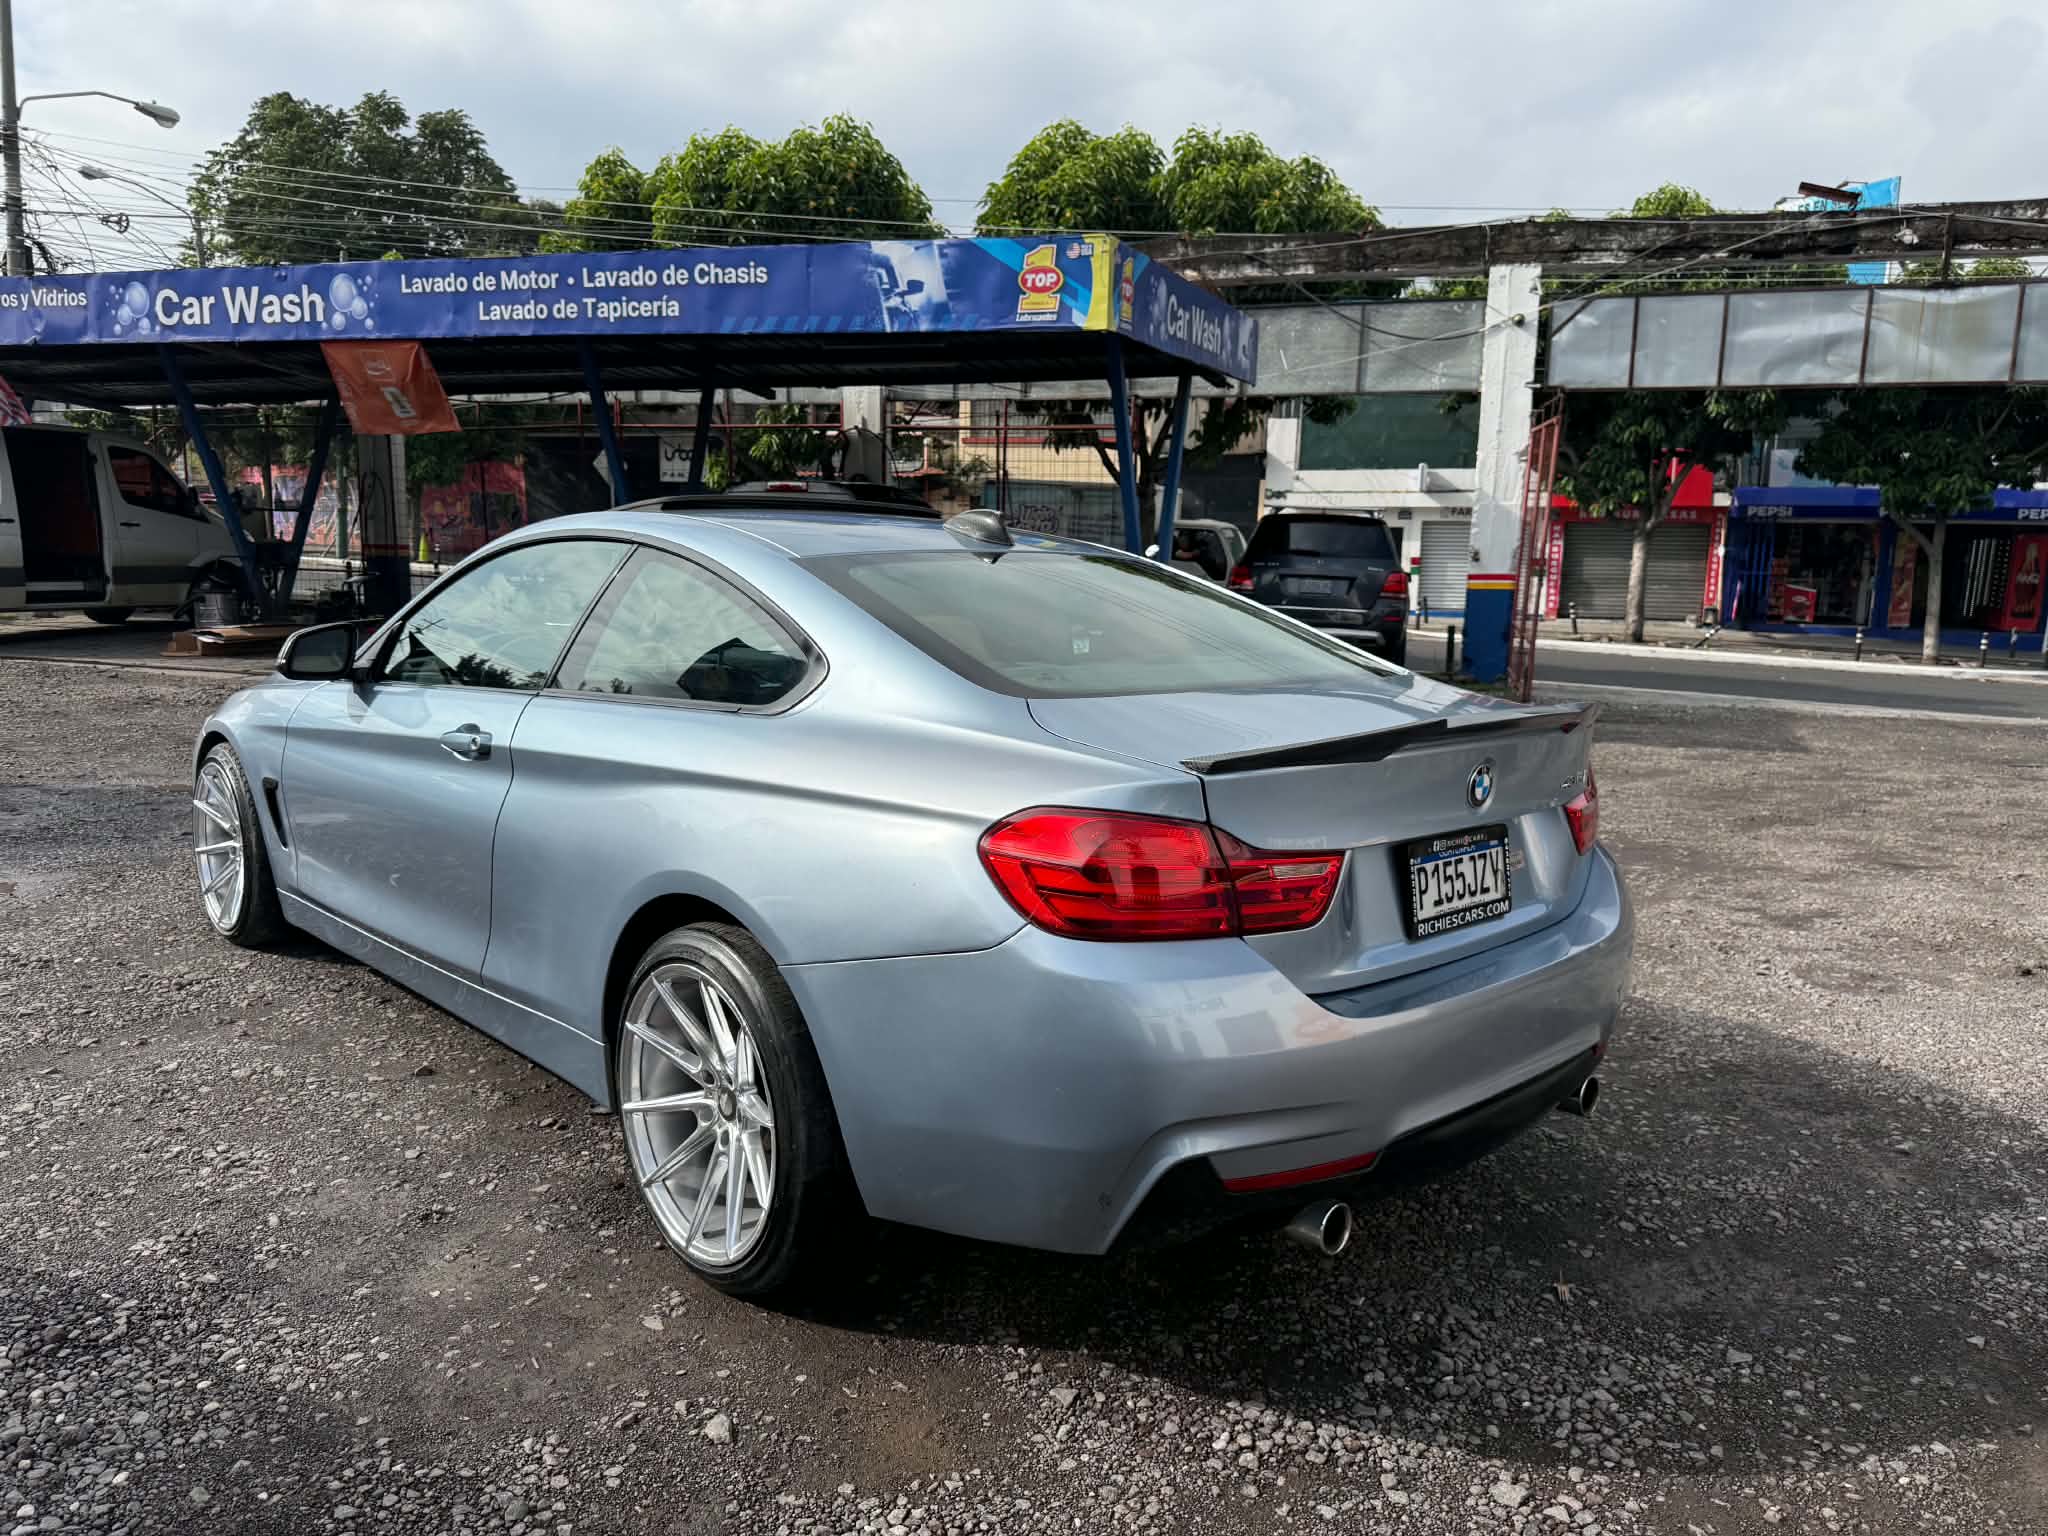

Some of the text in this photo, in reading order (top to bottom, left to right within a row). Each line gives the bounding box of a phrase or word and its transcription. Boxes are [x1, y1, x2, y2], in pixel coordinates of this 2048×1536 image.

[400, 261, 768, 294] Lavado de Motor Lavado de Chasis
[1023, 272, 1058, 289] TOP
[0, 287, 88, 312] os y Vidrios
[154, 284, 326, 327] Car Wash
[478, 295, 680, 323] Lavado de Tapicería
[1167, 293, 1222, 356] Car Wash
[1747, 506, 1793, 517] PEPSI
[1415, 849, 1501, 912] P155JZY
[1417, 900, 1510, 937] RICHIESCARS.COM
